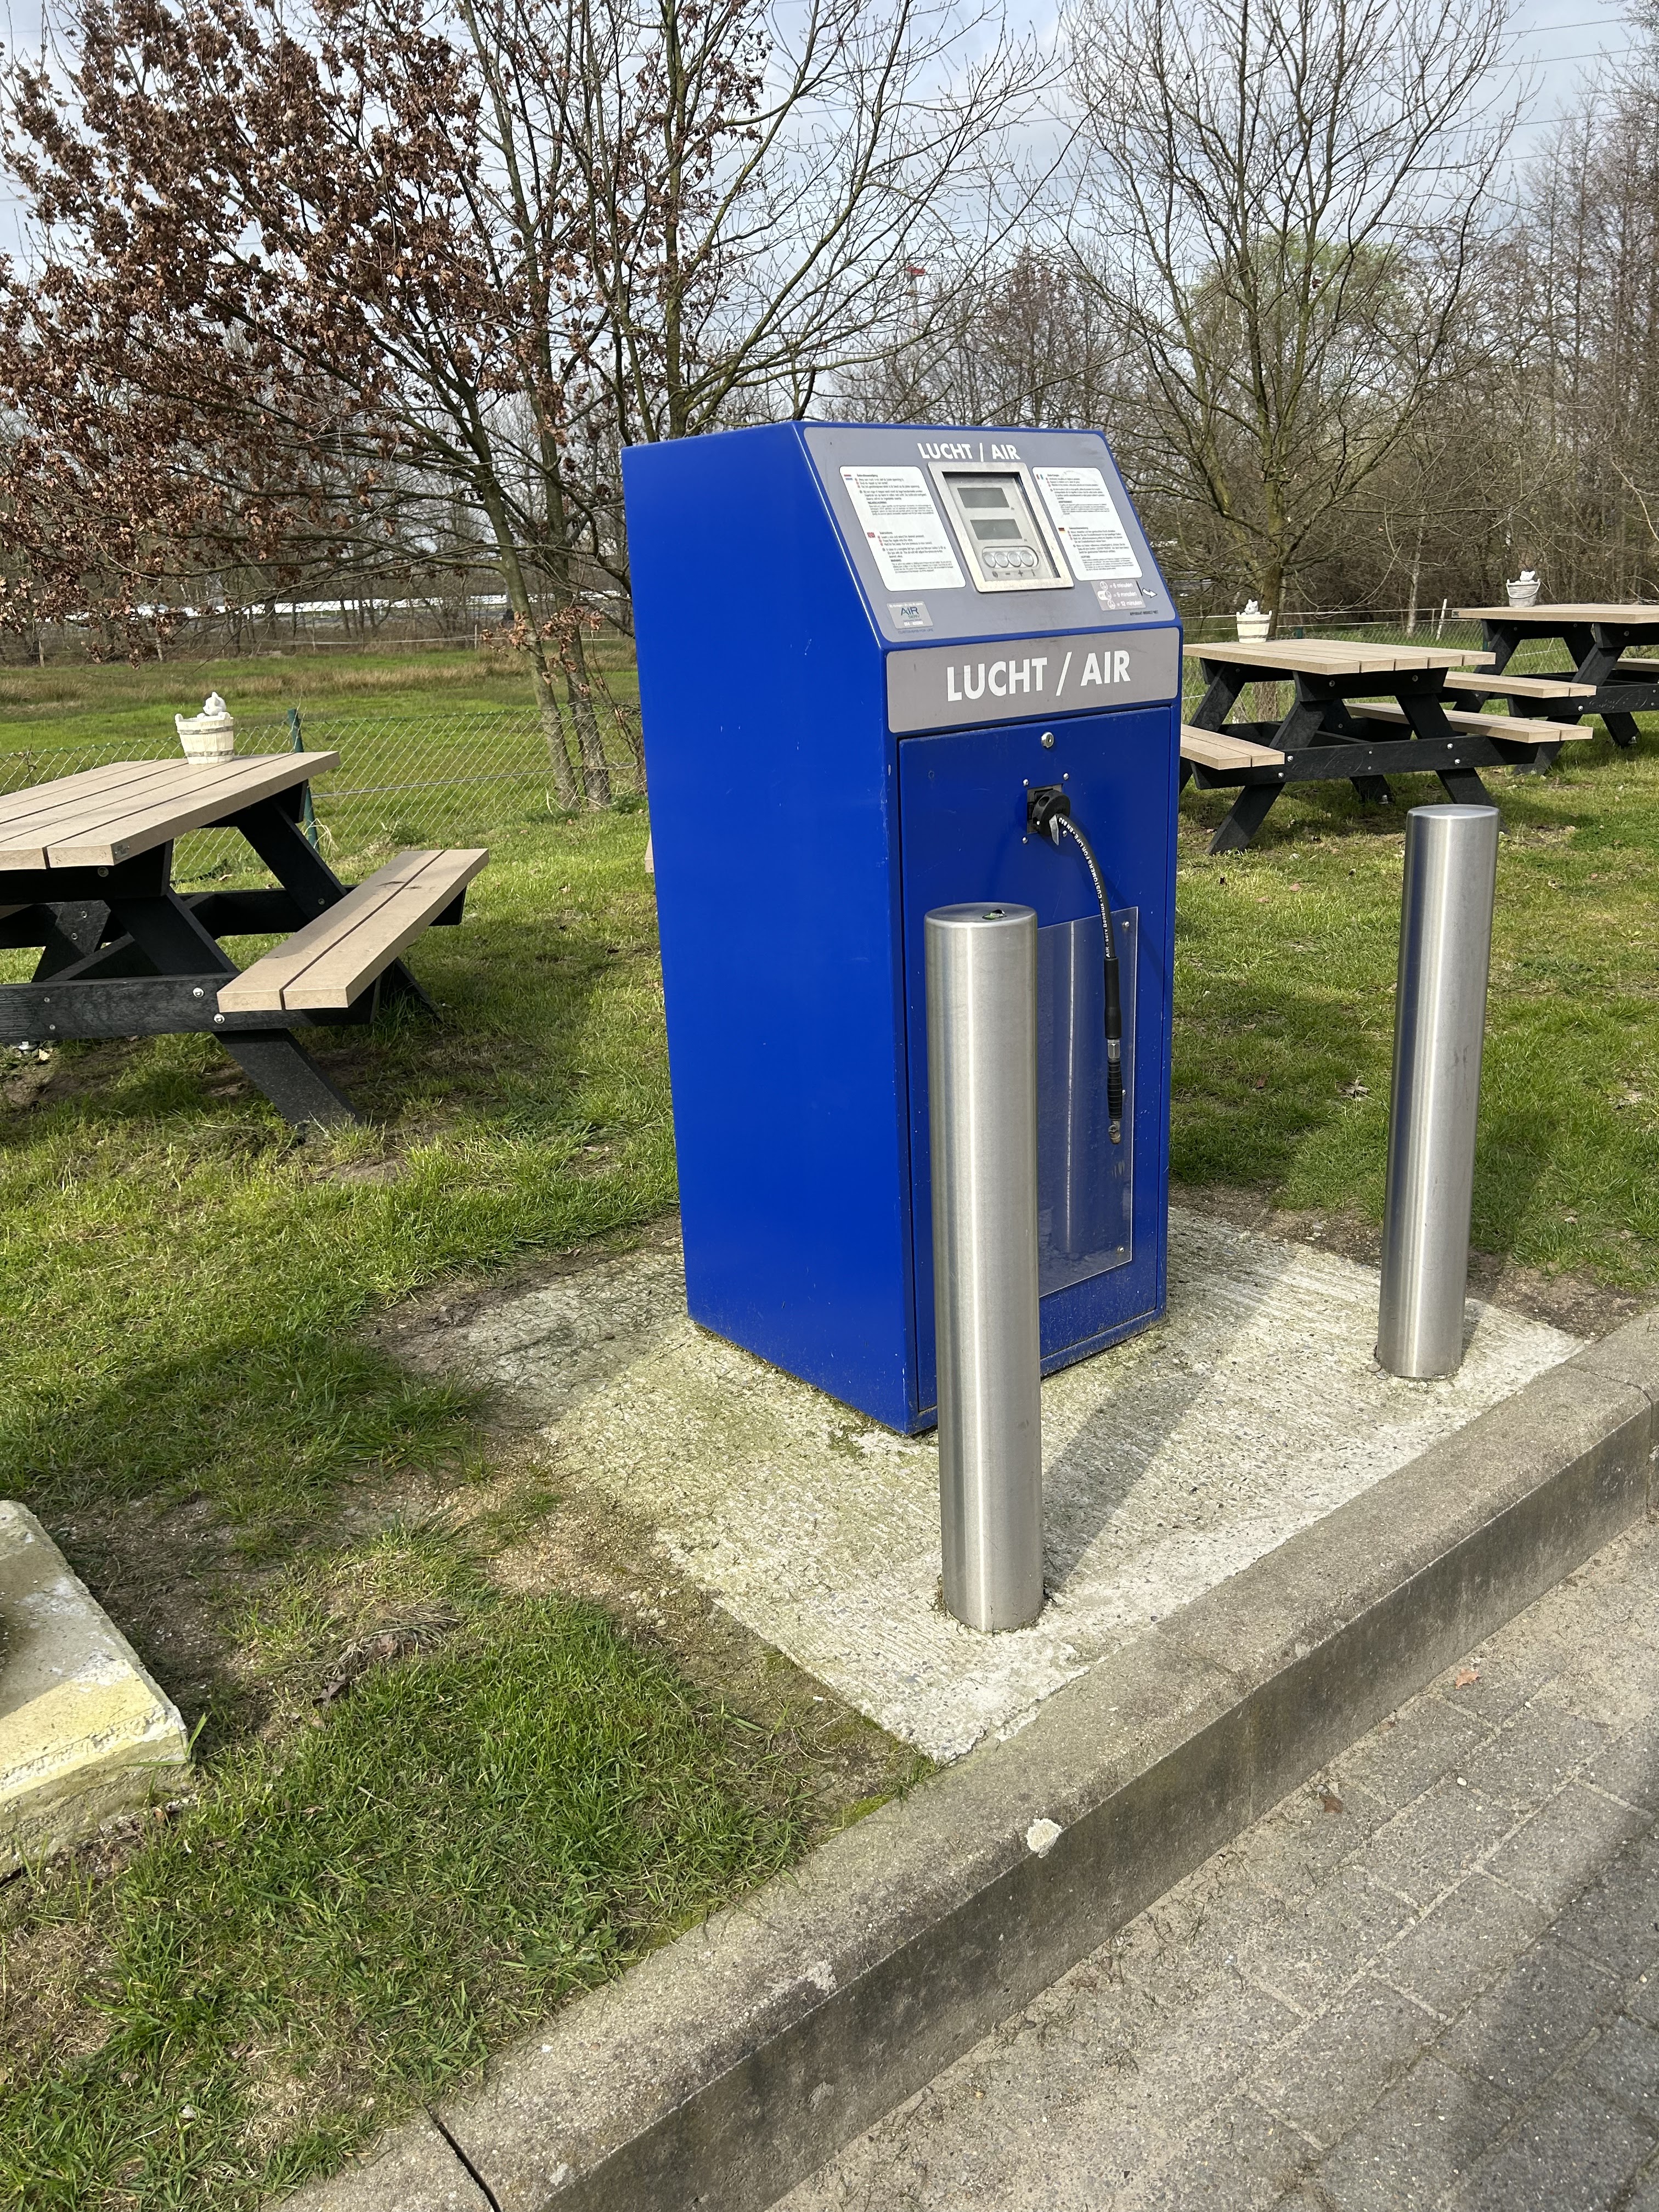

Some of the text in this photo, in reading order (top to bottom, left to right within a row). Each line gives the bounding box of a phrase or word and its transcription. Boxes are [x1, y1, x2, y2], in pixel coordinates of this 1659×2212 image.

[917, 442, 1021, 462] LUCHT / AIR
[901, 606, 919, 616] AIR
[947, 650, 1131, 702] LUCHT / AIR
[1074, 833, 1084, 848] LIFE
[1081, 846, 1090, 860] FOR
[1087, 859, 1102, 899] CUSTOMERS
